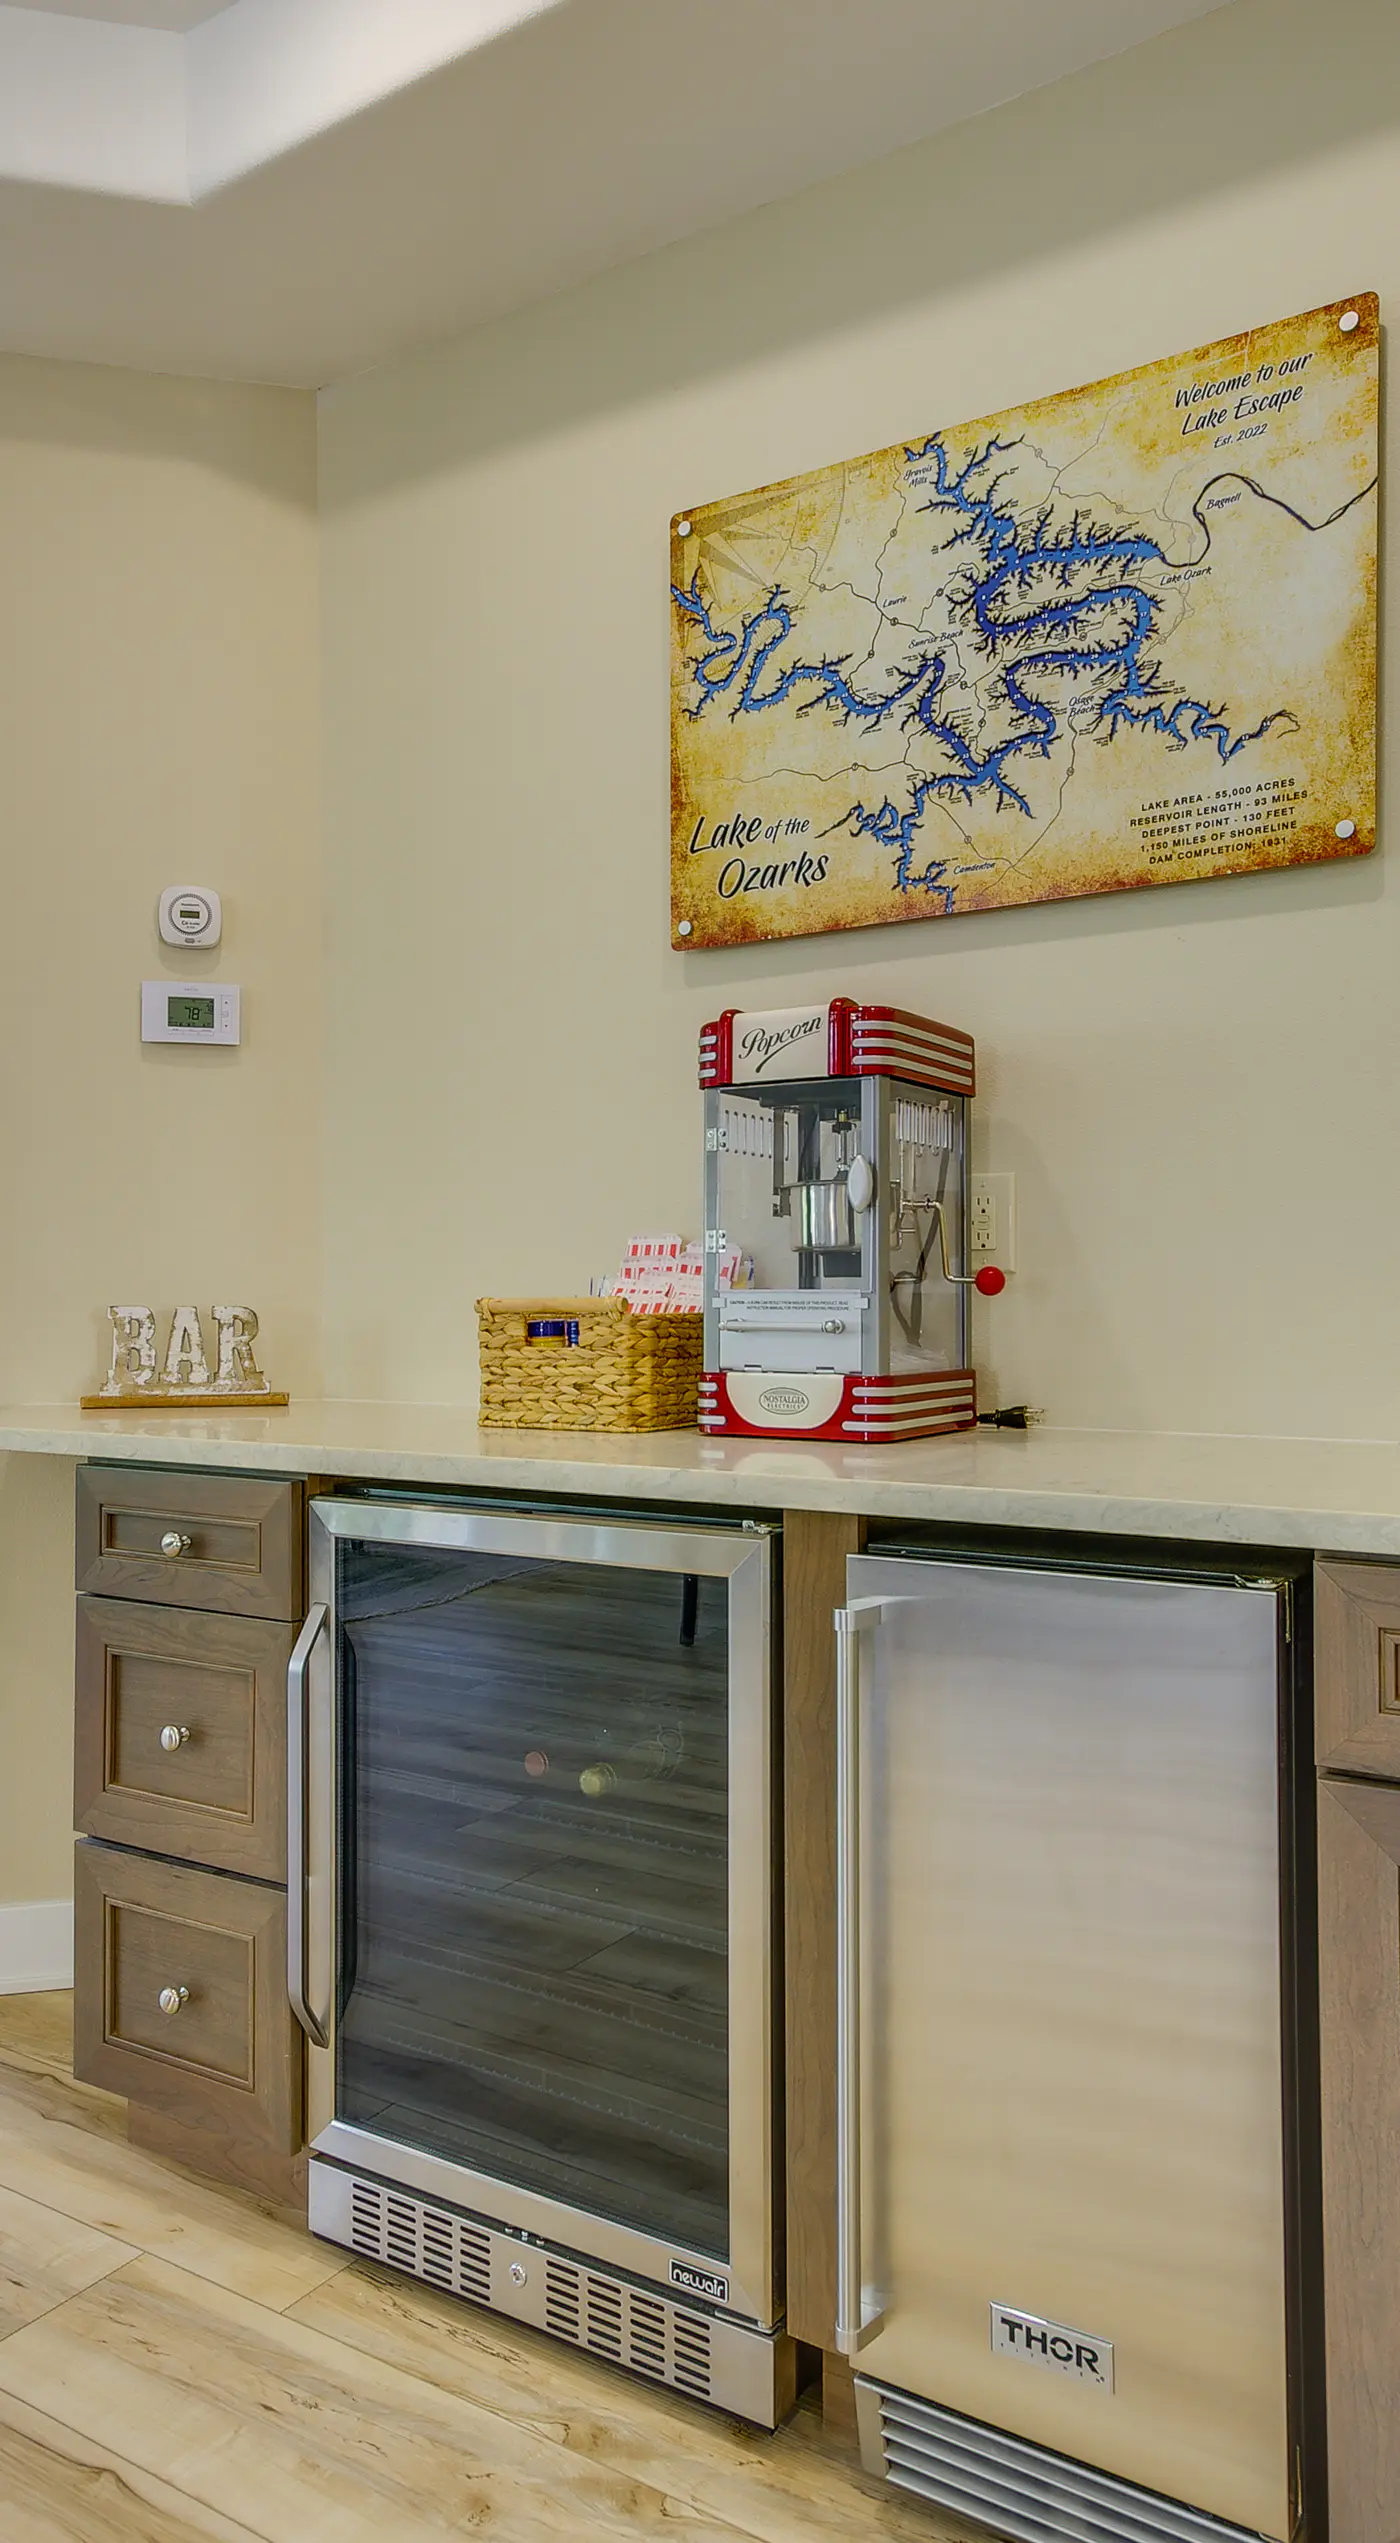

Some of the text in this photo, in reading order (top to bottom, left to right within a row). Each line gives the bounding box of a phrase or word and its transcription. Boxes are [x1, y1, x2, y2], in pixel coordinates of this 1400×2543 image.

[1175, 353, 1313, 408] Welcome to our
[1182, 385, 1303, 435] Lake Escape
[1214, 423, 1268, 448] Est. 2022
[903, 464, 933, 480] Gravois
[908, 477, 928, 488] Mills
[1205, 492, 1241, 510] Bagnell
[1160, 566, 1213, 586] Lake Ozark
[883, 596, 907, 608] Laurie
[908, 630, 964, 649] Sunrise Beach
[1069, 696, 1095, 707] Osage
[1070, 705, 1095, 717] Beach
[1141, 799, 1169, 812] LAKE
[1174, 794, 1203, 807] AREA
[1215, 786, 1251, 800] 55,000
[1256, 778, 1295, 792] ACRES
[1130, 810, 1192, 827] RESERVOIR
[1197, 801, 1241, 816] LENGTH
[1254, 798, 1267, 807] 93
[1272, 790, 1308, 804] MILES
[690, 813, 810, 854] Lake of the
[1142, 823, 1191, 839] DEEPEST
[1196, 817, 1230, 830] POINT
[1243, 812, 1262, 823] 130
[1267, 806, 1295, 819] FEET
[1140, 820, 1297, 853] 1,150 MILES OF SHORELINE
[1149, 854, 1173, 864] DAM
[1178, 843, 1256, 861] COMPLETION:
[718, 851, 829, 898] Ozarks
[953, 862, 996, 875] Camdenton
[184, 1005, 200, 1020] 78
[738, 1017, 822, 1060] Popcorn
[107, 1305, 265, 1386] BAR
[763, 1395, 805, 1404] NOSTALGIA
[673, 2268, 724, 2297] newair
[1000, 2316, 1100, 2375] THOR
